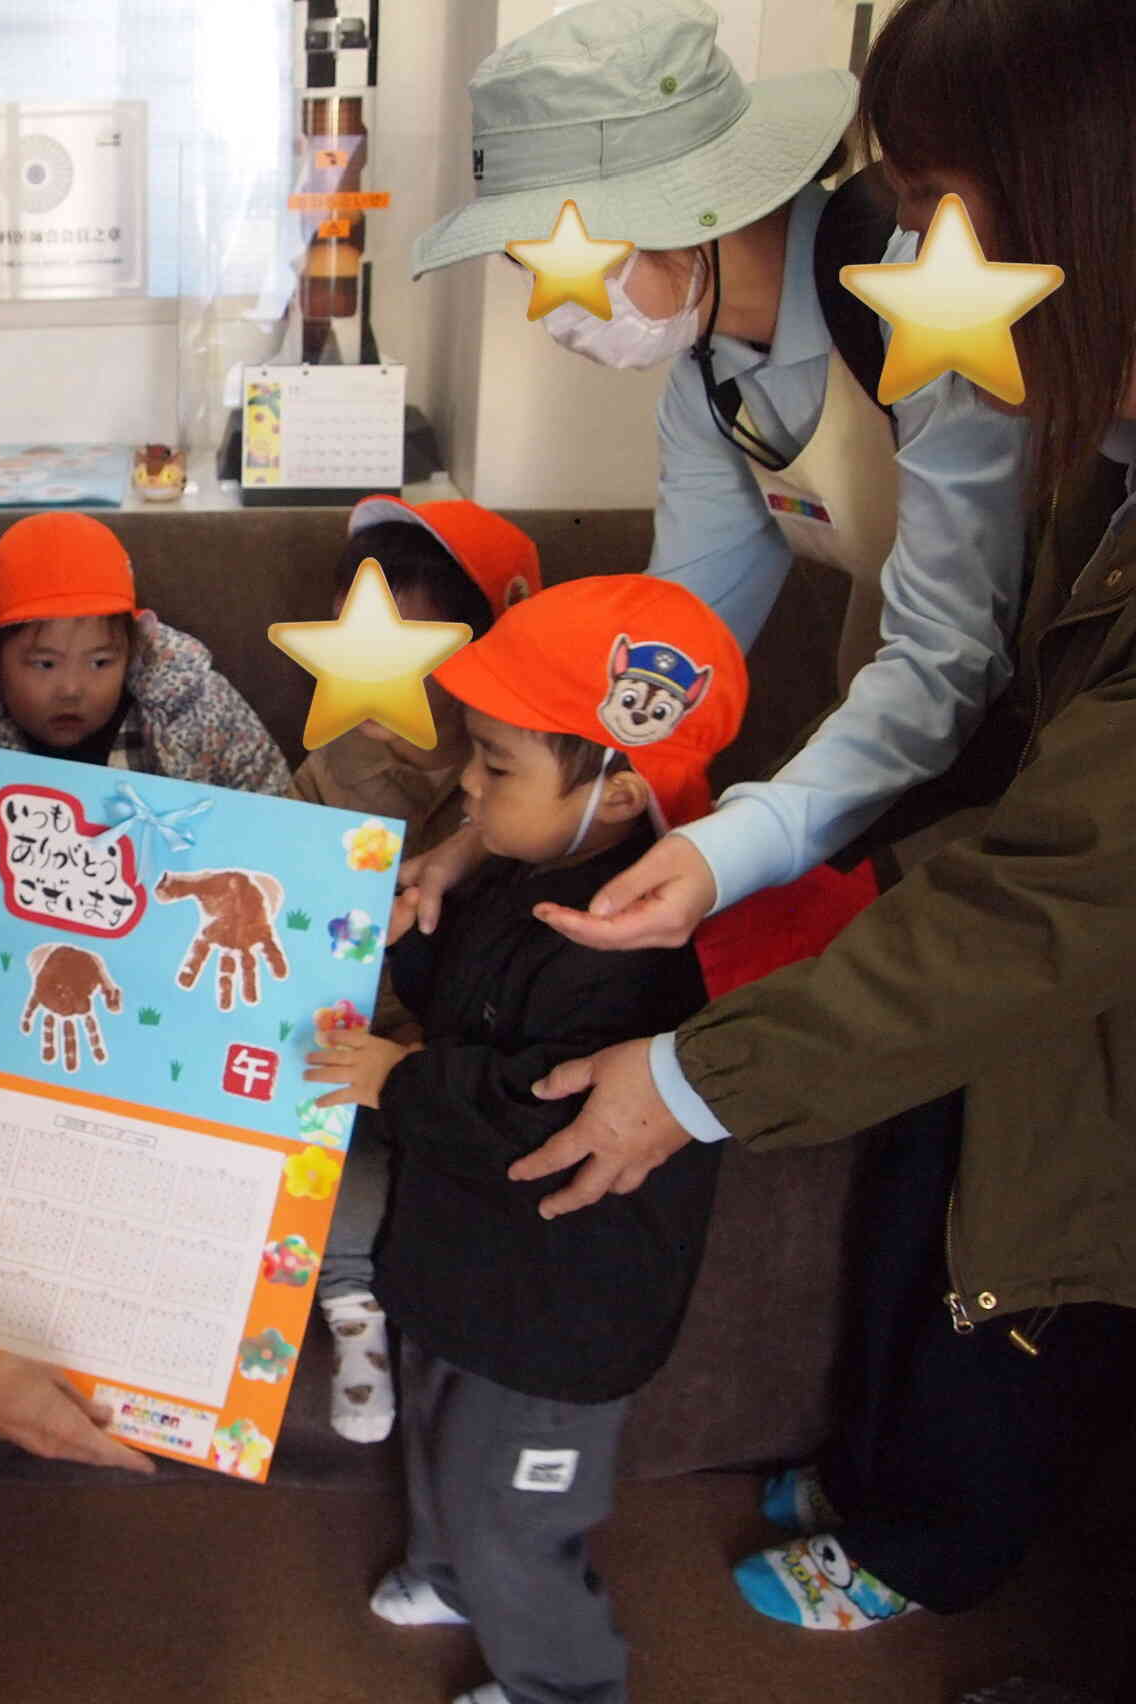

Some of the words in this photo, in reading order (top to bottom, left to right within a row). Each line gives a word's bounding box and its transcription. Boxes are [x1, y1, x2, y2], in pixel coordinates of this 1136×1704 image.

[5, 800, 72, 832] いつも
[10, 834, 120, 885] ありがとう
[19, 878, 134, 926] ございます
[231, 1049, 270, 1093] 午
